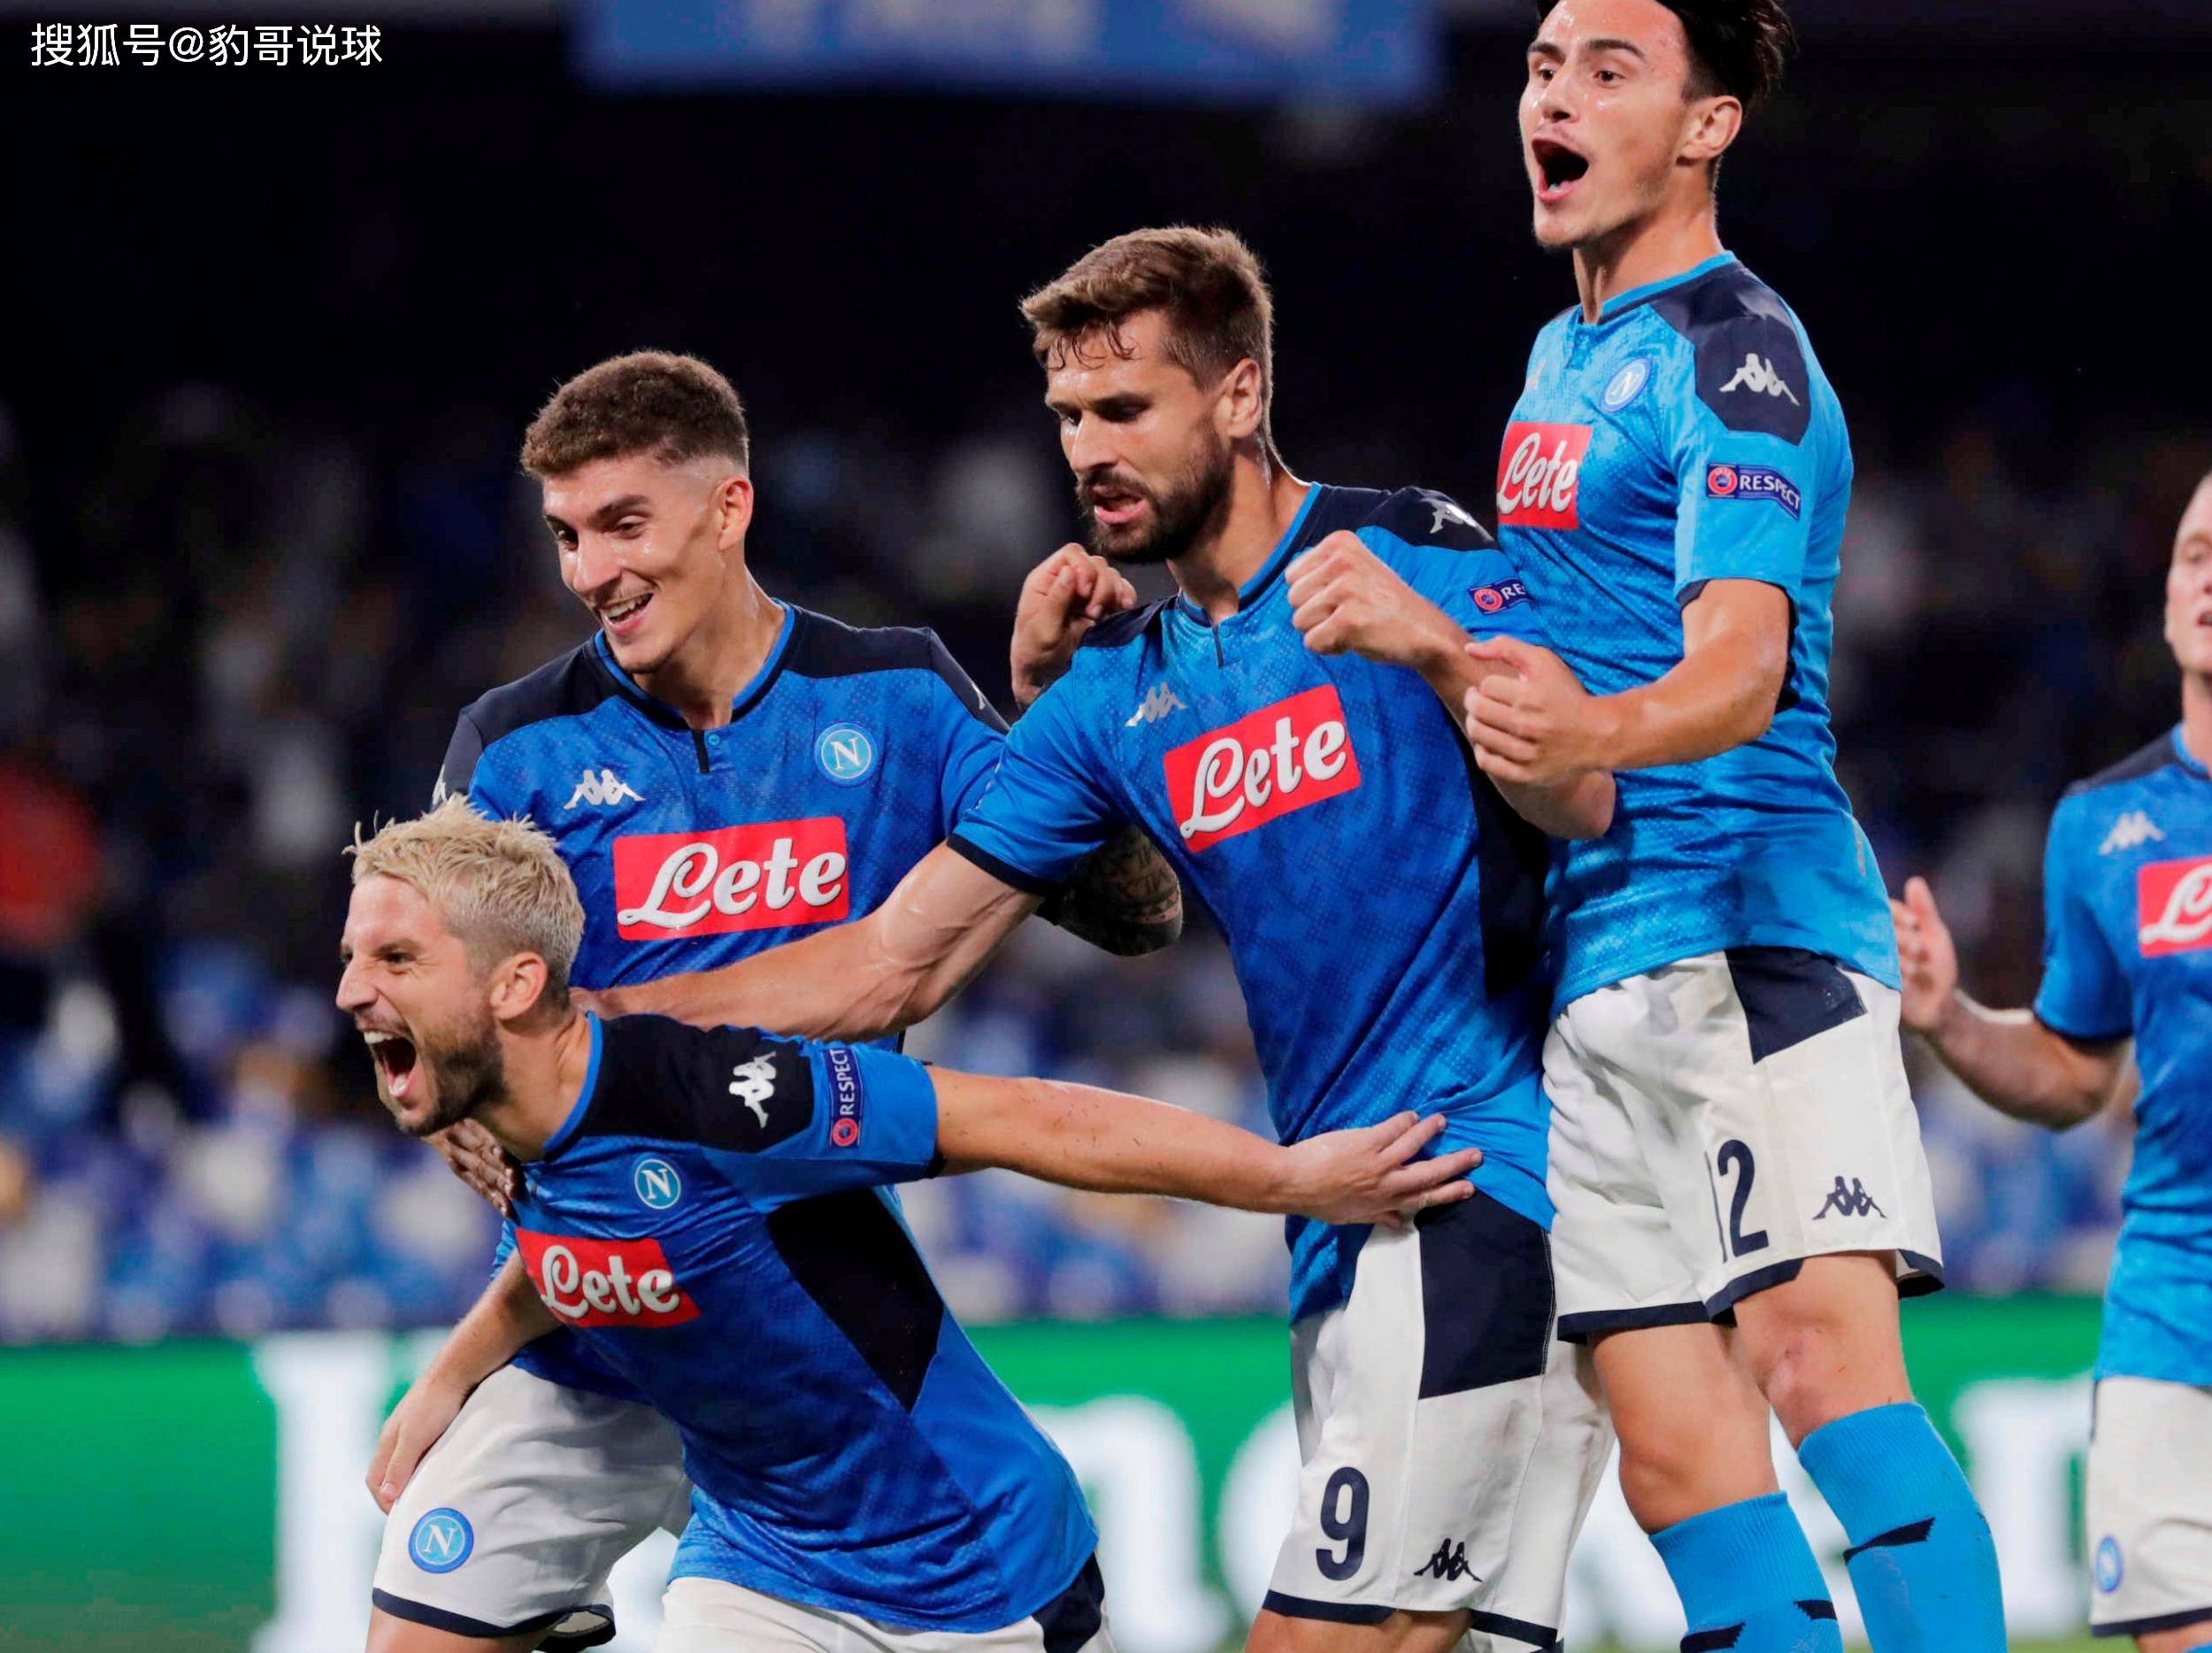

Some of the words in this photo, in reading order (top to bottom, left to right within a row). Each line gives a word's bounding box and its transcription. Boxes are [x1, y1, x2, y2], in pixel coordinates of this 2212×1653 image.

[1496, 432, 1578, 515] Lete
[1739, 474, 1801, 510] RESPECT
[1501, 583, 1525, 600] RE
[830, 738, 863, 770] N
[1179, 716, 1346, 838] Lete
[617, 837, 846, 929] Lete
[830, 1049, 856, 1116] RESPECT
[642, 1168, 672, 1200] N
[541, 1244, 680, 1319] Lete
[424, 1525, 457, 1556] N
[1315, 1466, 1371, 1582] 9
